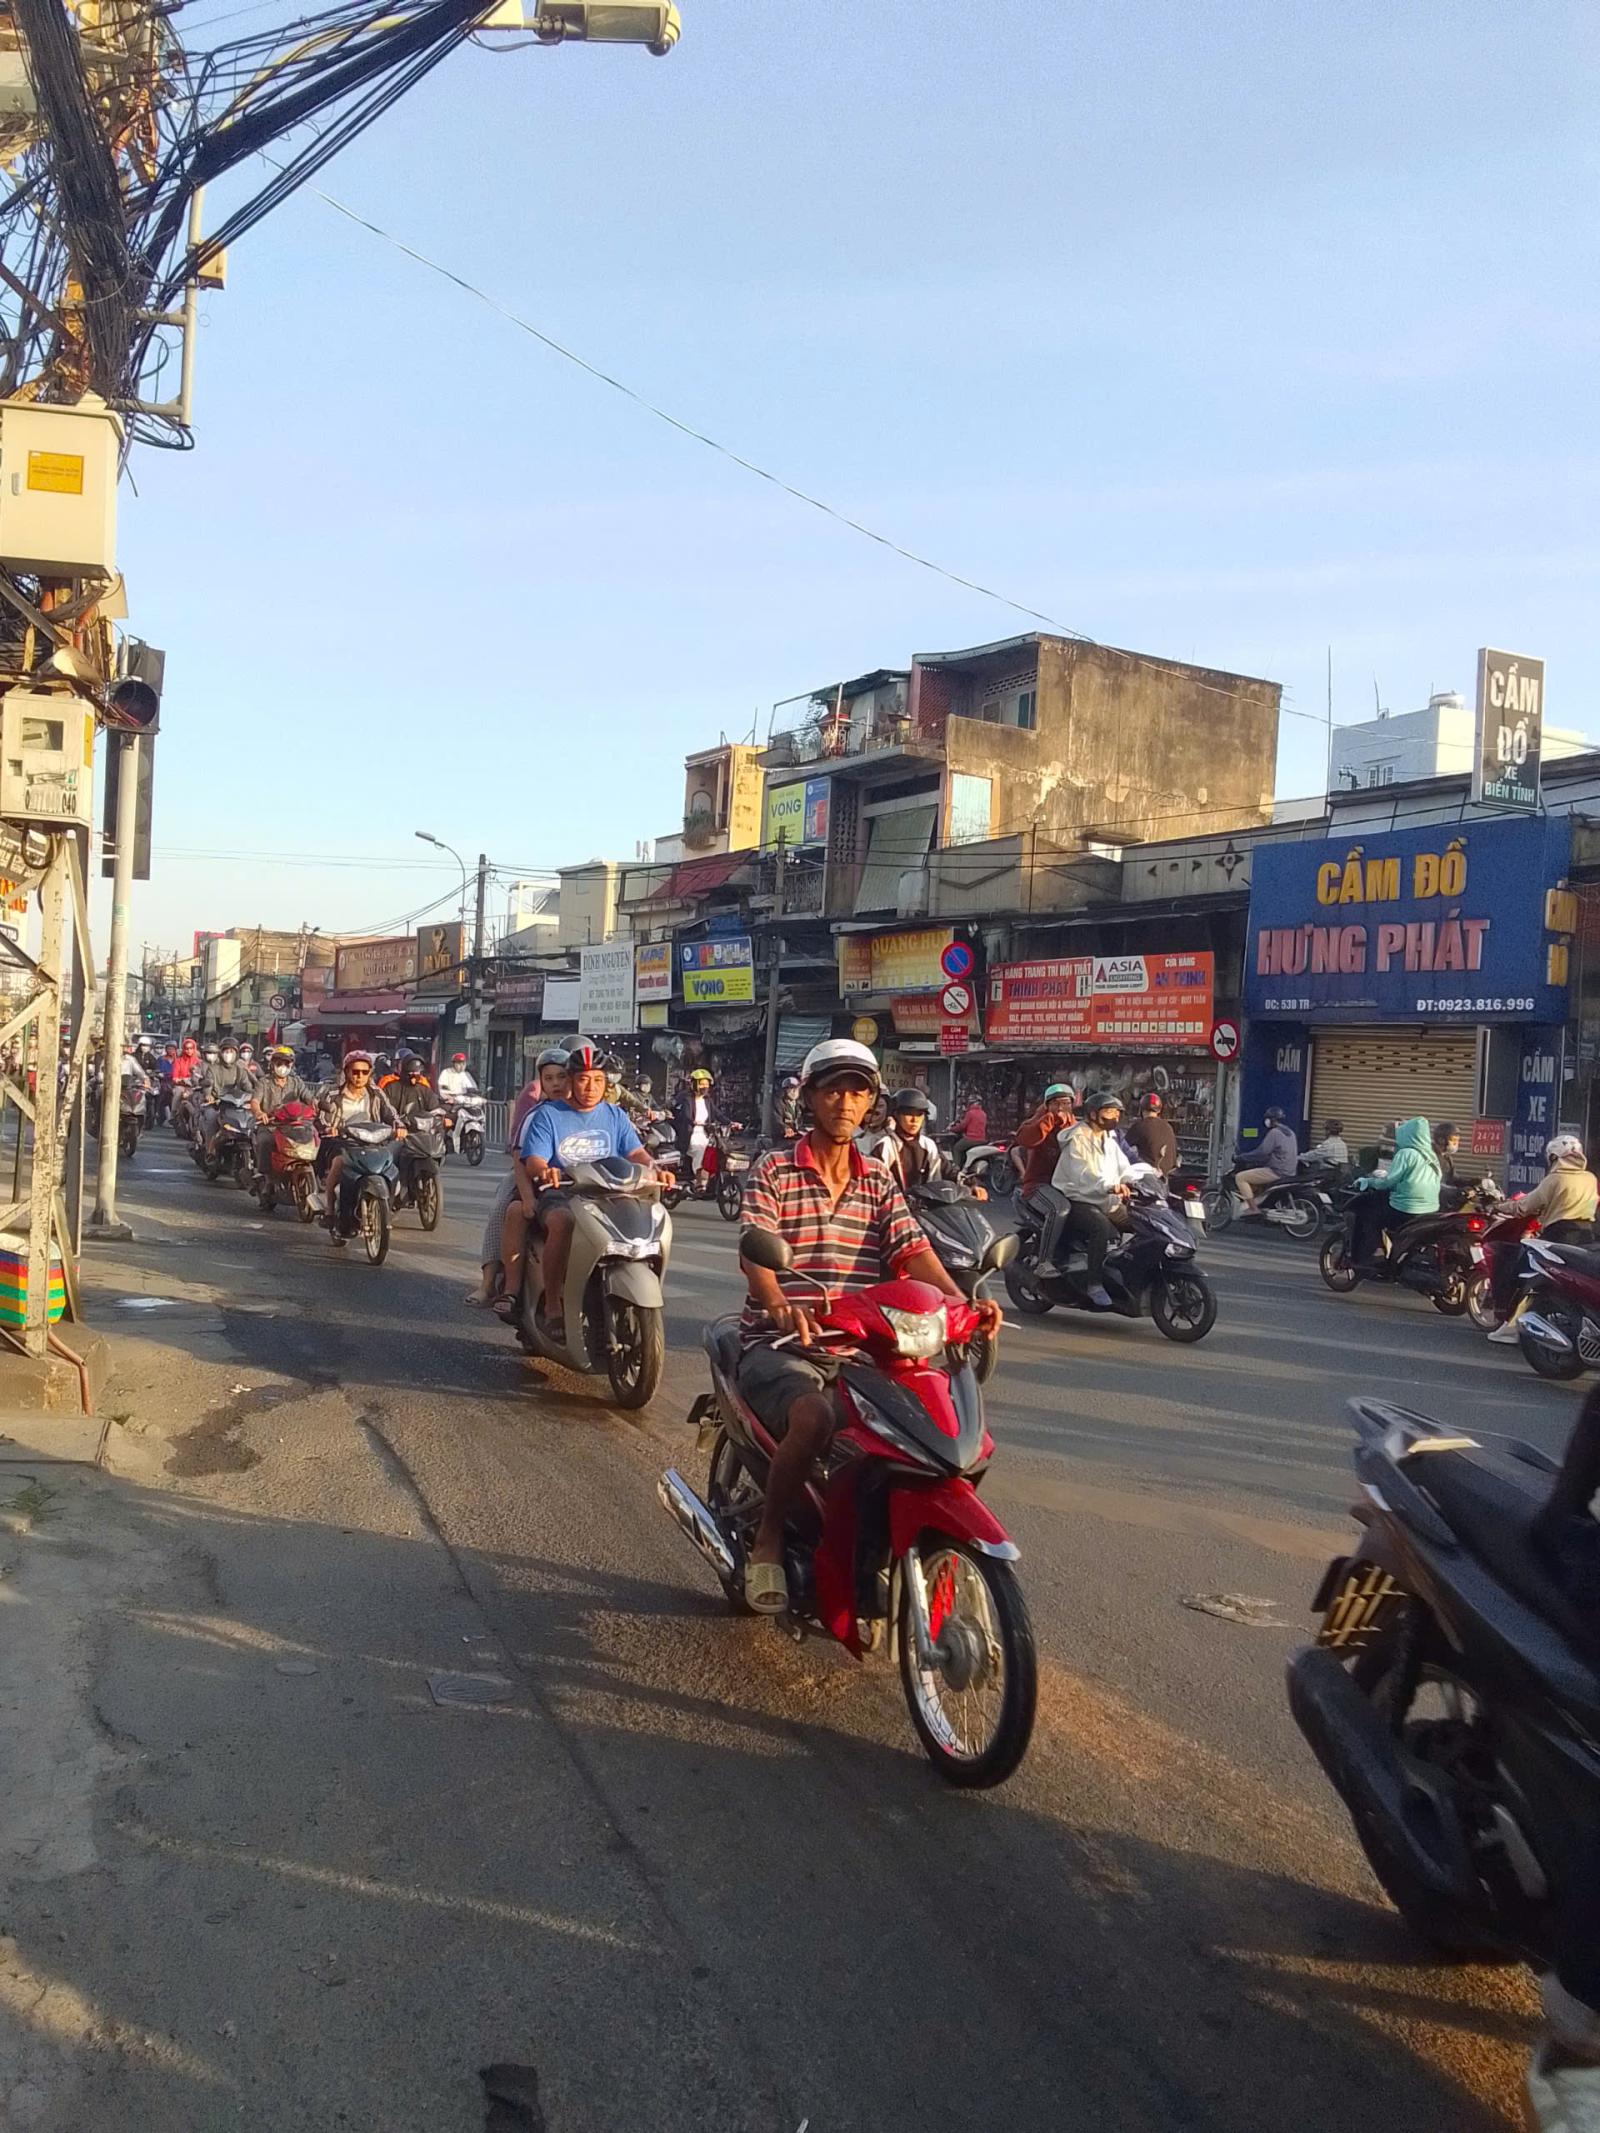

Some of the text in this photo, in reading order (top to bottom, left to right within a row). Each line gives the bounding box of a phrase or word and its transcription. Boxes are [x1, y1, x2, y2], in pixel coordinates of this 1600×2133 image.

[1504, 765, 1518, 780] XE
[1512, 782, 1535, 803] TỈNH
[771, 799, 801, 820] VỌNG
[1317, 837, 1468, 906] CẦM ĐỒ
[1257, 908, 1491, 975] HƯNG PHÁT
[1024, 965, 1046, 977] TRANG
[1047, 963, 1058, 976] TRÍ
[1074, 960, 1092, 975] THẤT
[1109, 961, 1143, 972] ASIA
[1417, 998, 1535, 1011] ĐT:0923.816.996
[1528, 1096, 1547, 1122] XE
